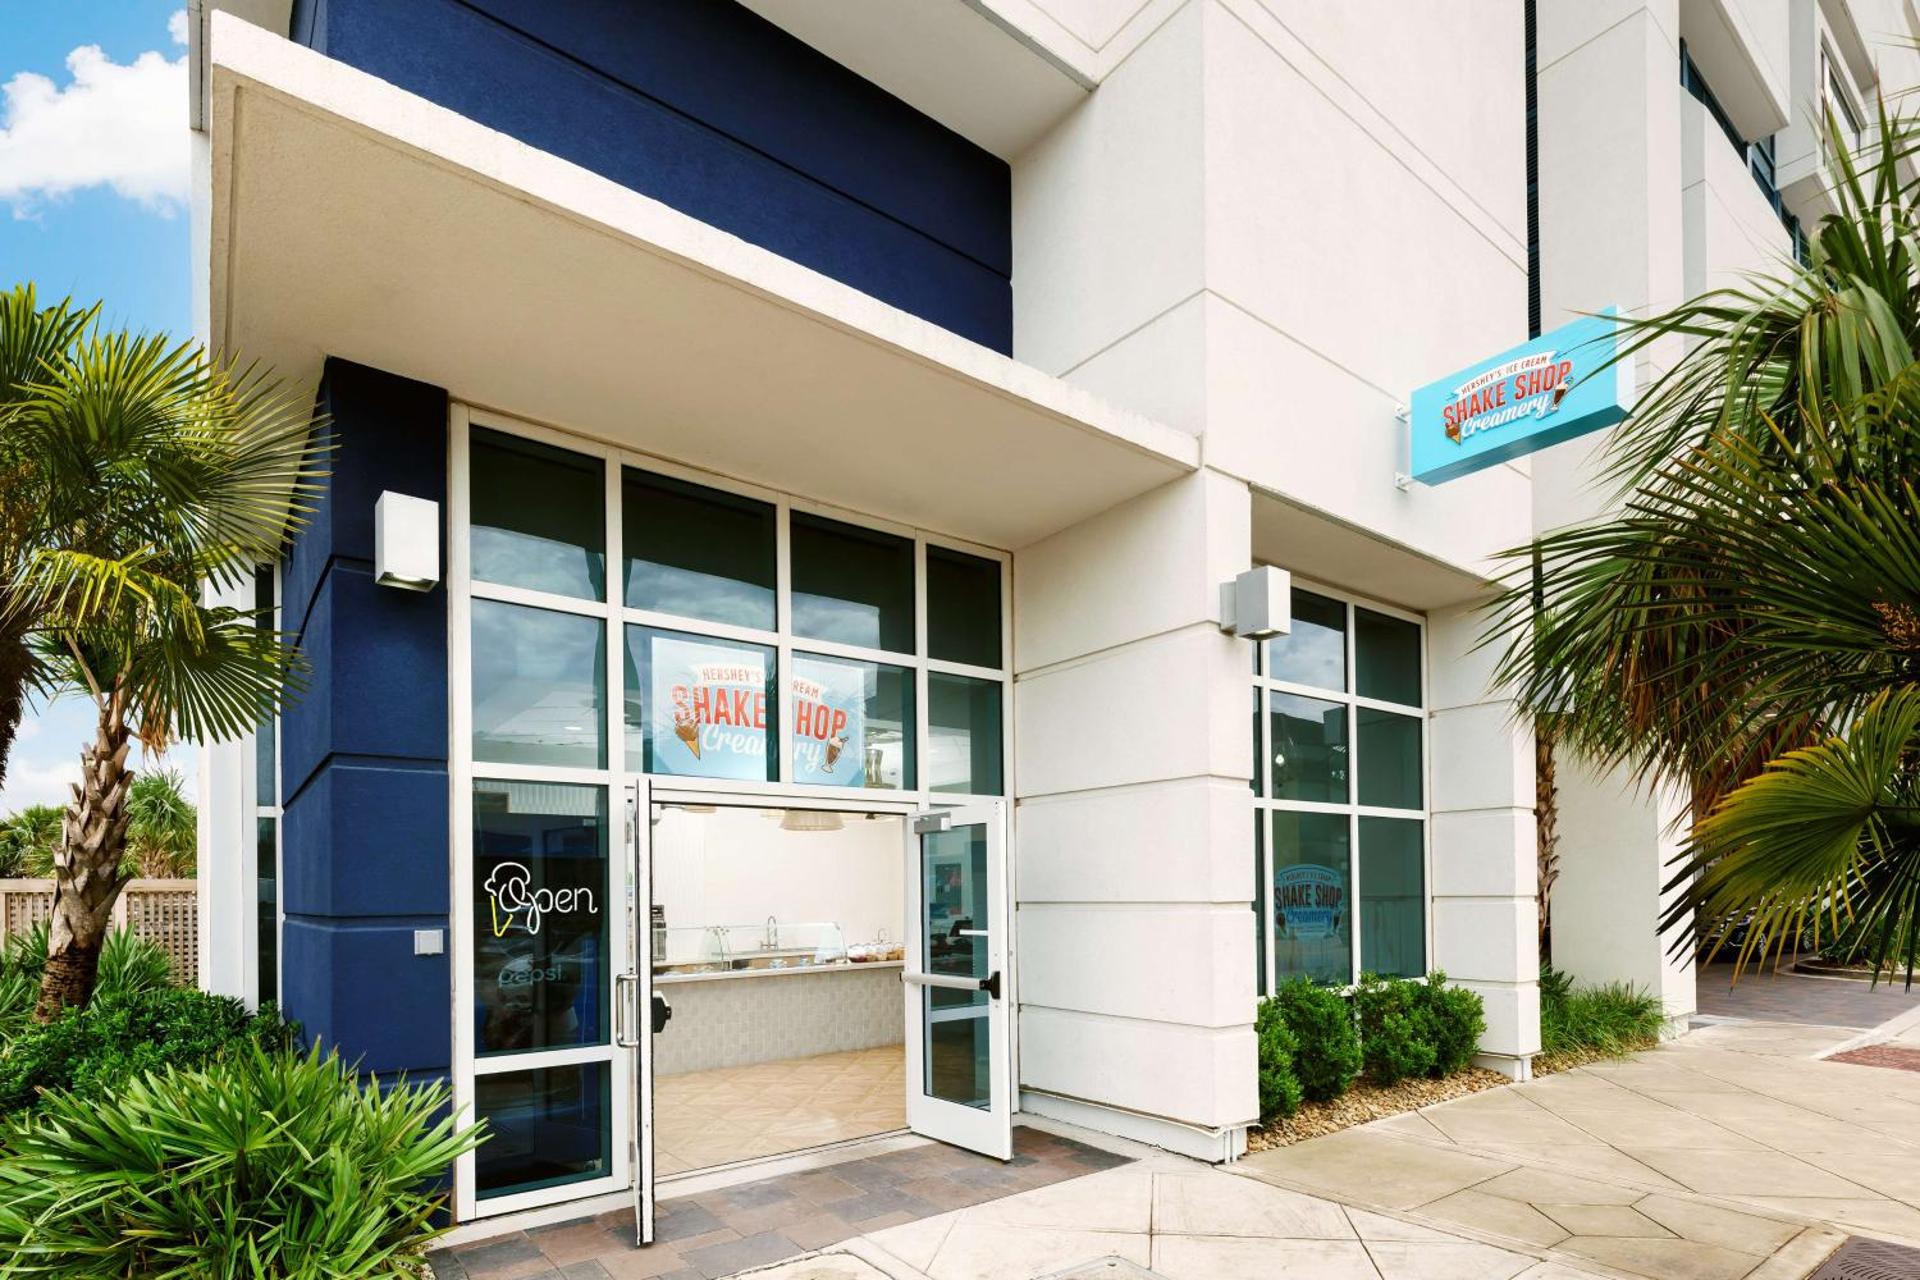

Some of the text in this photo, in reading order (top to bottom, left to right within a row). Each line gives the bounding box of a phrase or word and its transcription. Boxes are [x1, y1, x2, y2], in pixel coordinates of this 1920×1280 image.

[1443, 361, 1572, 429] SHAKE SHOP
[1461, 356, 1547, 395] HERSHEY'S ICE CREAM
[1461, 394, 1549, 437] Creamery
[702, 667, 819, 698] HERSHEY'S REAM
[671, 684, 847, 740] SHAKE HOP
[498, 876, 598, 935] Open
[1274, 884, 1342, 911] SHAKE SHOP
